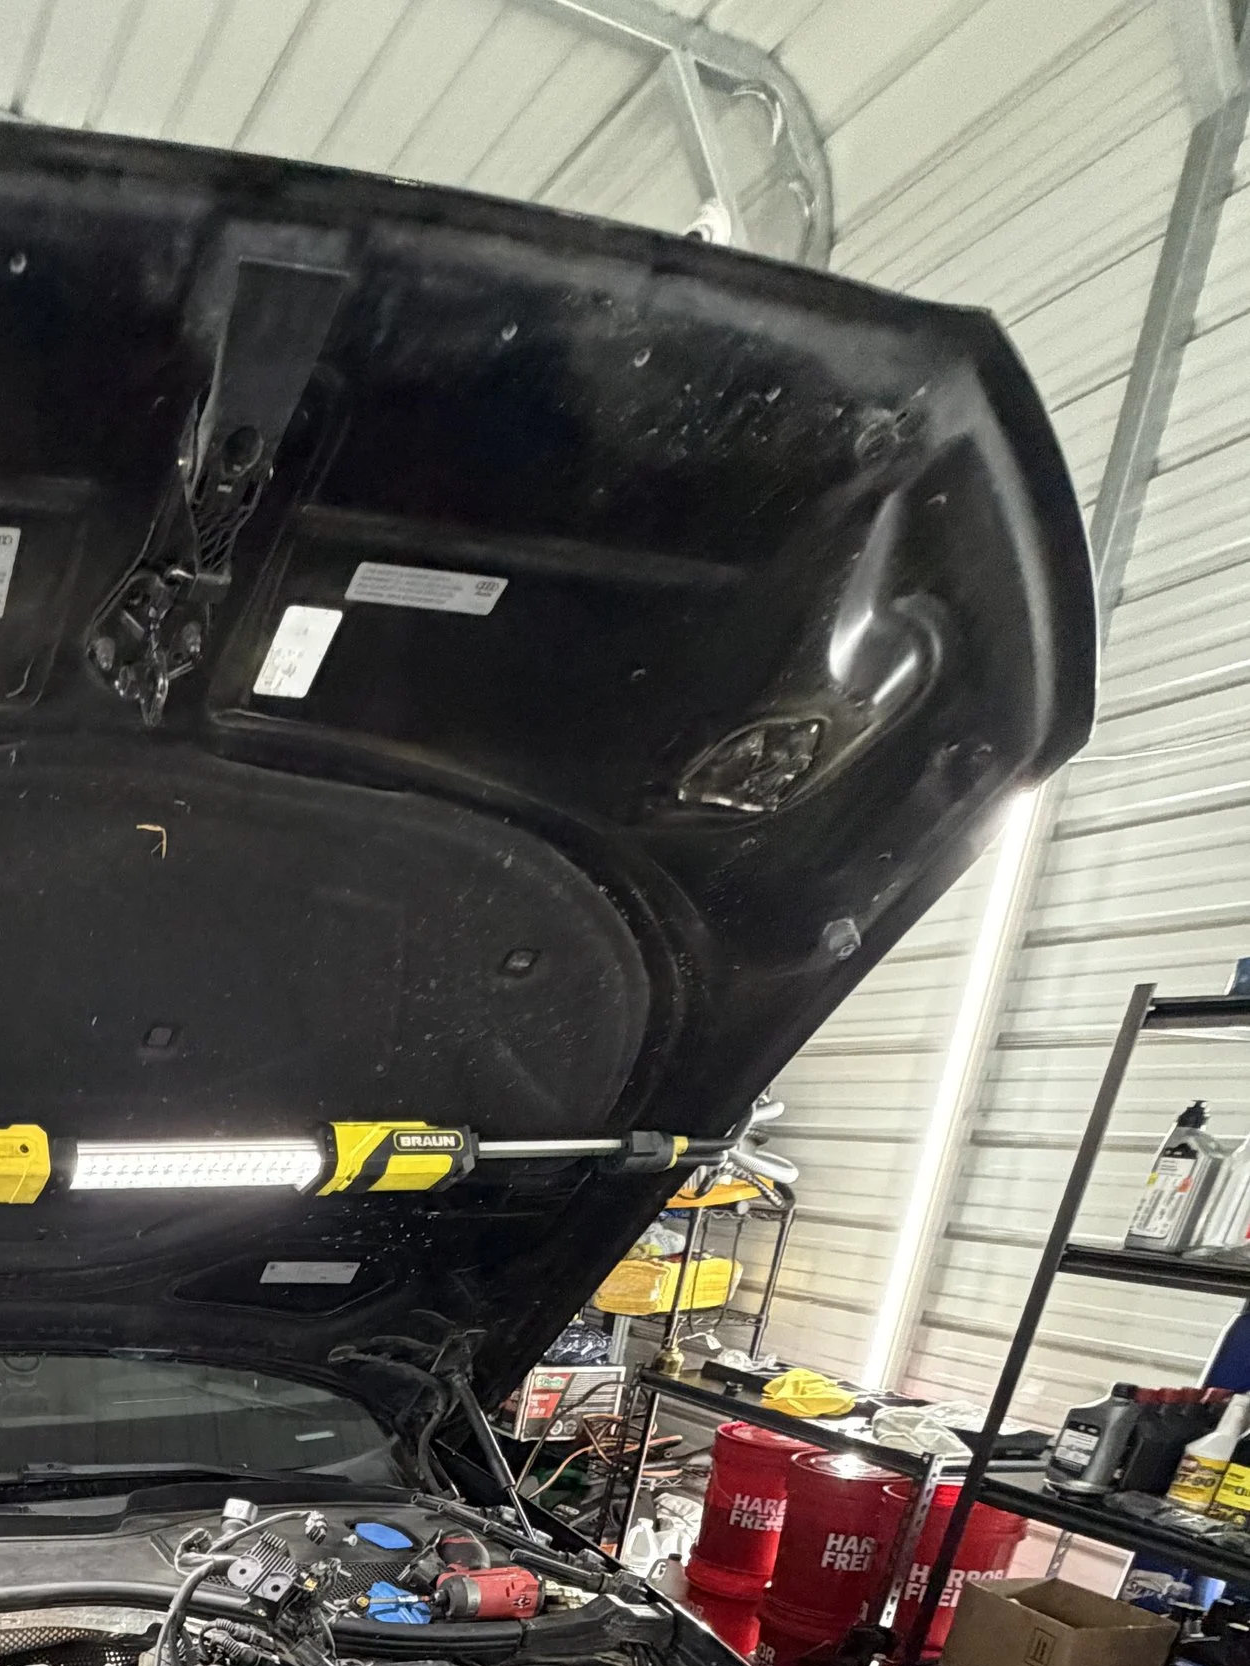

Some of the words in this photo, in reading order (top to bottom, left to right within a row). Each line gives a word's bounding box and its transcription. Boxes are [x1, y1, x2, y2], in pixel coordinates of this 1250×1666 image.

[400, 1135, 456, 1147] BRAUN
[825, 1533, 877, 1553] HAR
[821, 1550, 870, 1571] FREI
